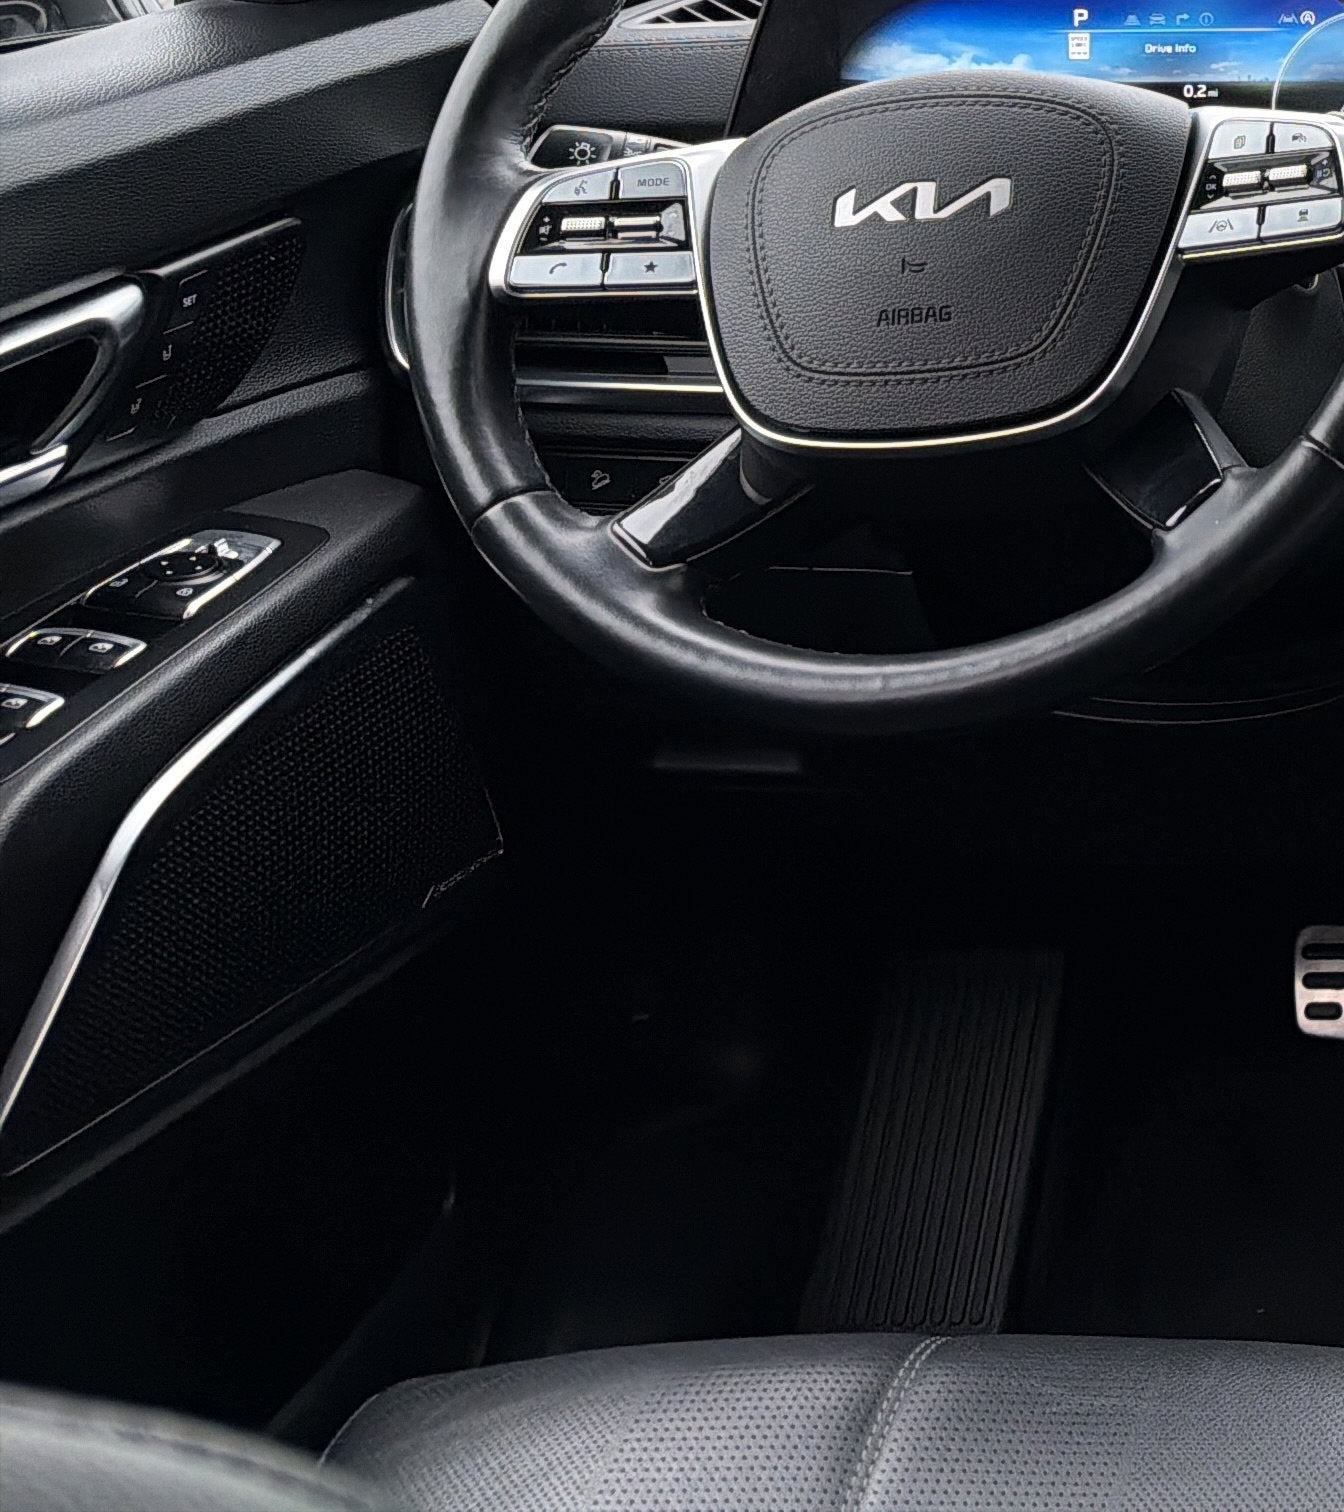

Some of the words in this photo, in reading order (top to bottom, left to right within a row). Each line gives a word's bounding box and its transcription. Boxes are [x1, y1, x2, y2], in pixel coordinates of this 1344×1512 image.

[1073, 8, 1089, 27] P
[1144, 43, 1173, 54] Drive
[1175, 43, 1197, 54] Info
[1183, 84, 1208, 98] 0.2
[636, 176, 671, 188] MODE
[182, 293, 198, 308] SET
[876, 304, 953, 328] AIRBAG
